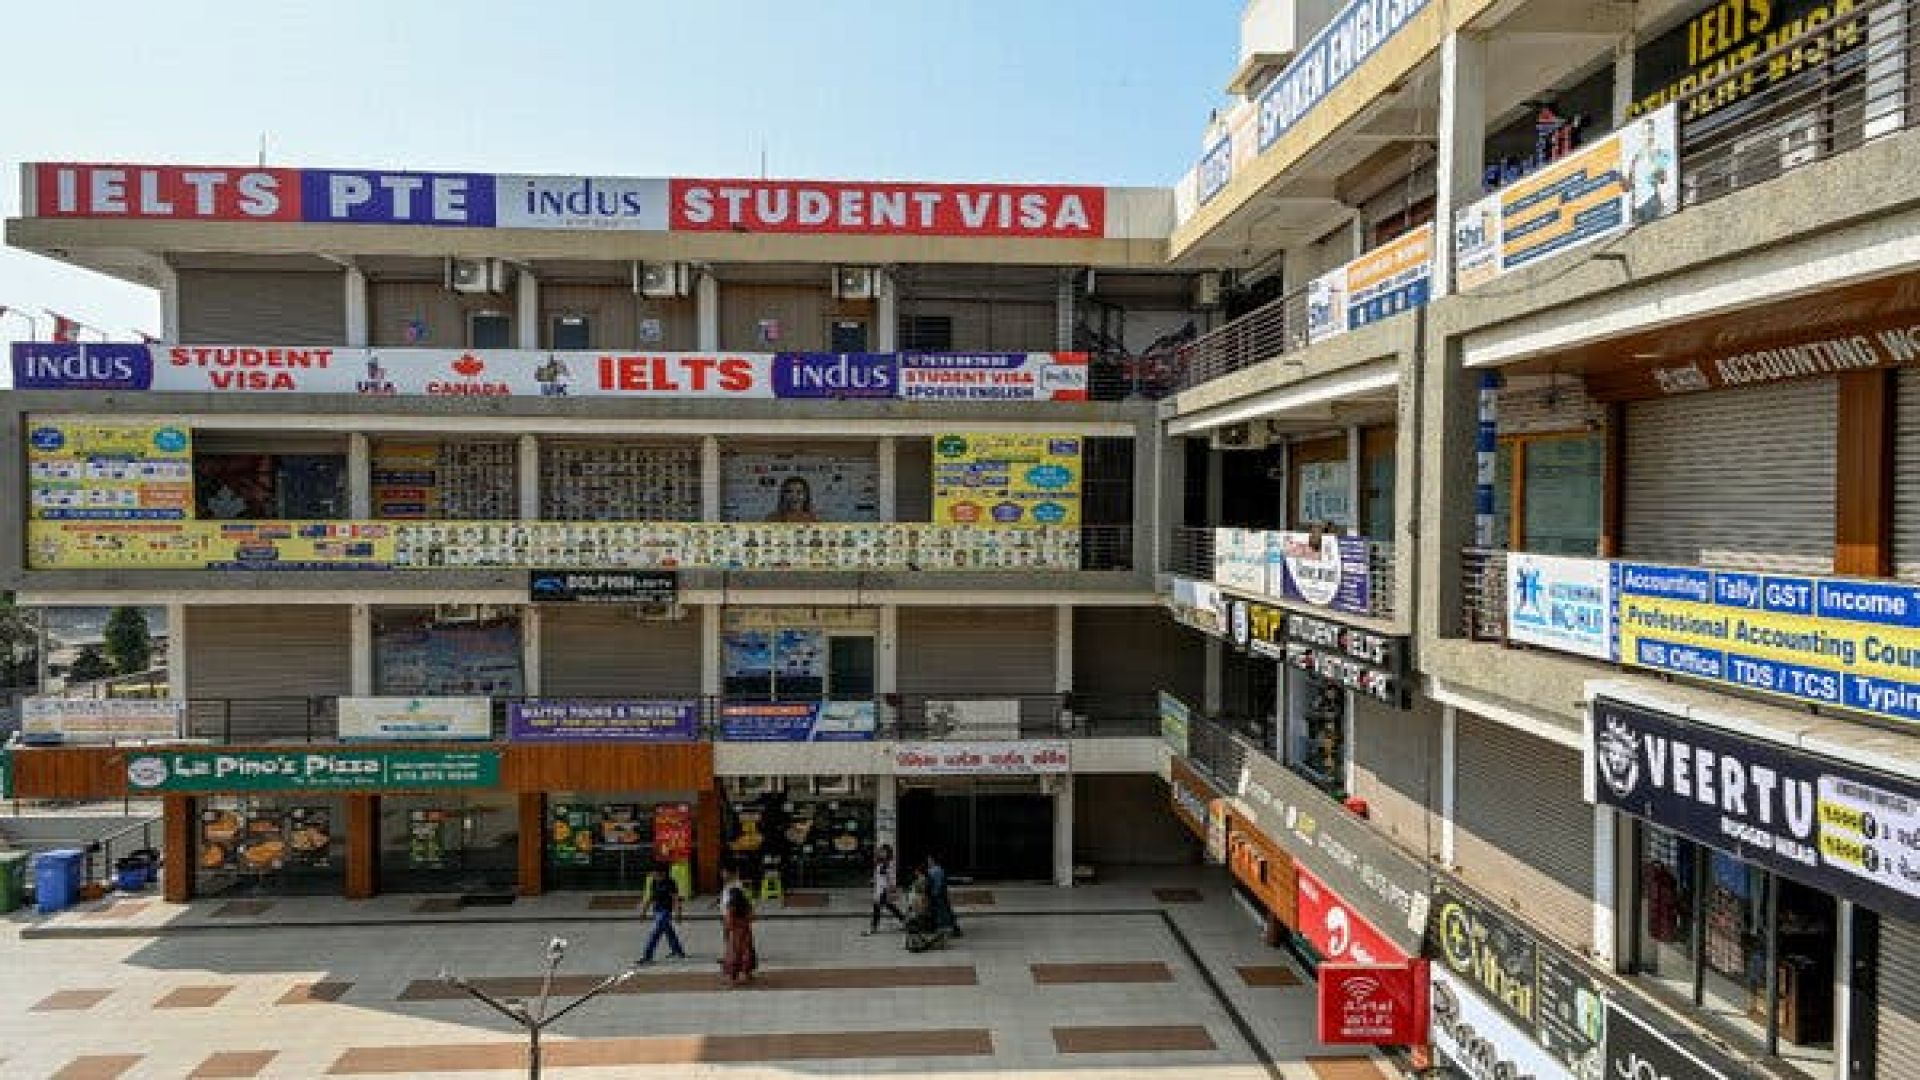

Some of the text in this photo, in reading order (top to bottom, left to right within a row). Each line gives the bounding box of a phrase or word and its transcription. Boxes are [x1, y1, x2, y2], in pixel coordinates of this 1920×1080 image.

[1689, 0, 1770, 66] IELTS
[57, 169, 281, 216] IELTS
[330, 174, 468, 222] PTE
[684, 189, 942, 229] STUDENT
[956, 193, 1091, 230] VISA
[170, 347, 333, 369] STUDENT
[598, 356, 753, 391] IELTS
[1715, 335, 1879, 385] ACCOUNTING
[209, 370, 296, 391] VISA
[1625, 570, 1708, 600] Accounting
[1718, 578, 1759, 608] Tally
[1765, 583, 1811, 609] GST
[1823, 586, 1907, 617] Income
[1627, 606, 1730, 640] Professional
[1737, 619, 1856, 665] Accounting
[1669, 648, 1721, 675] Office
[1734, 659, 1776, 686] TDS
[1789, 671, 1837, 698] TCS
[304, 755, 379, 777] Pizza
[1644, 733, 1813, 840] VEERTU
